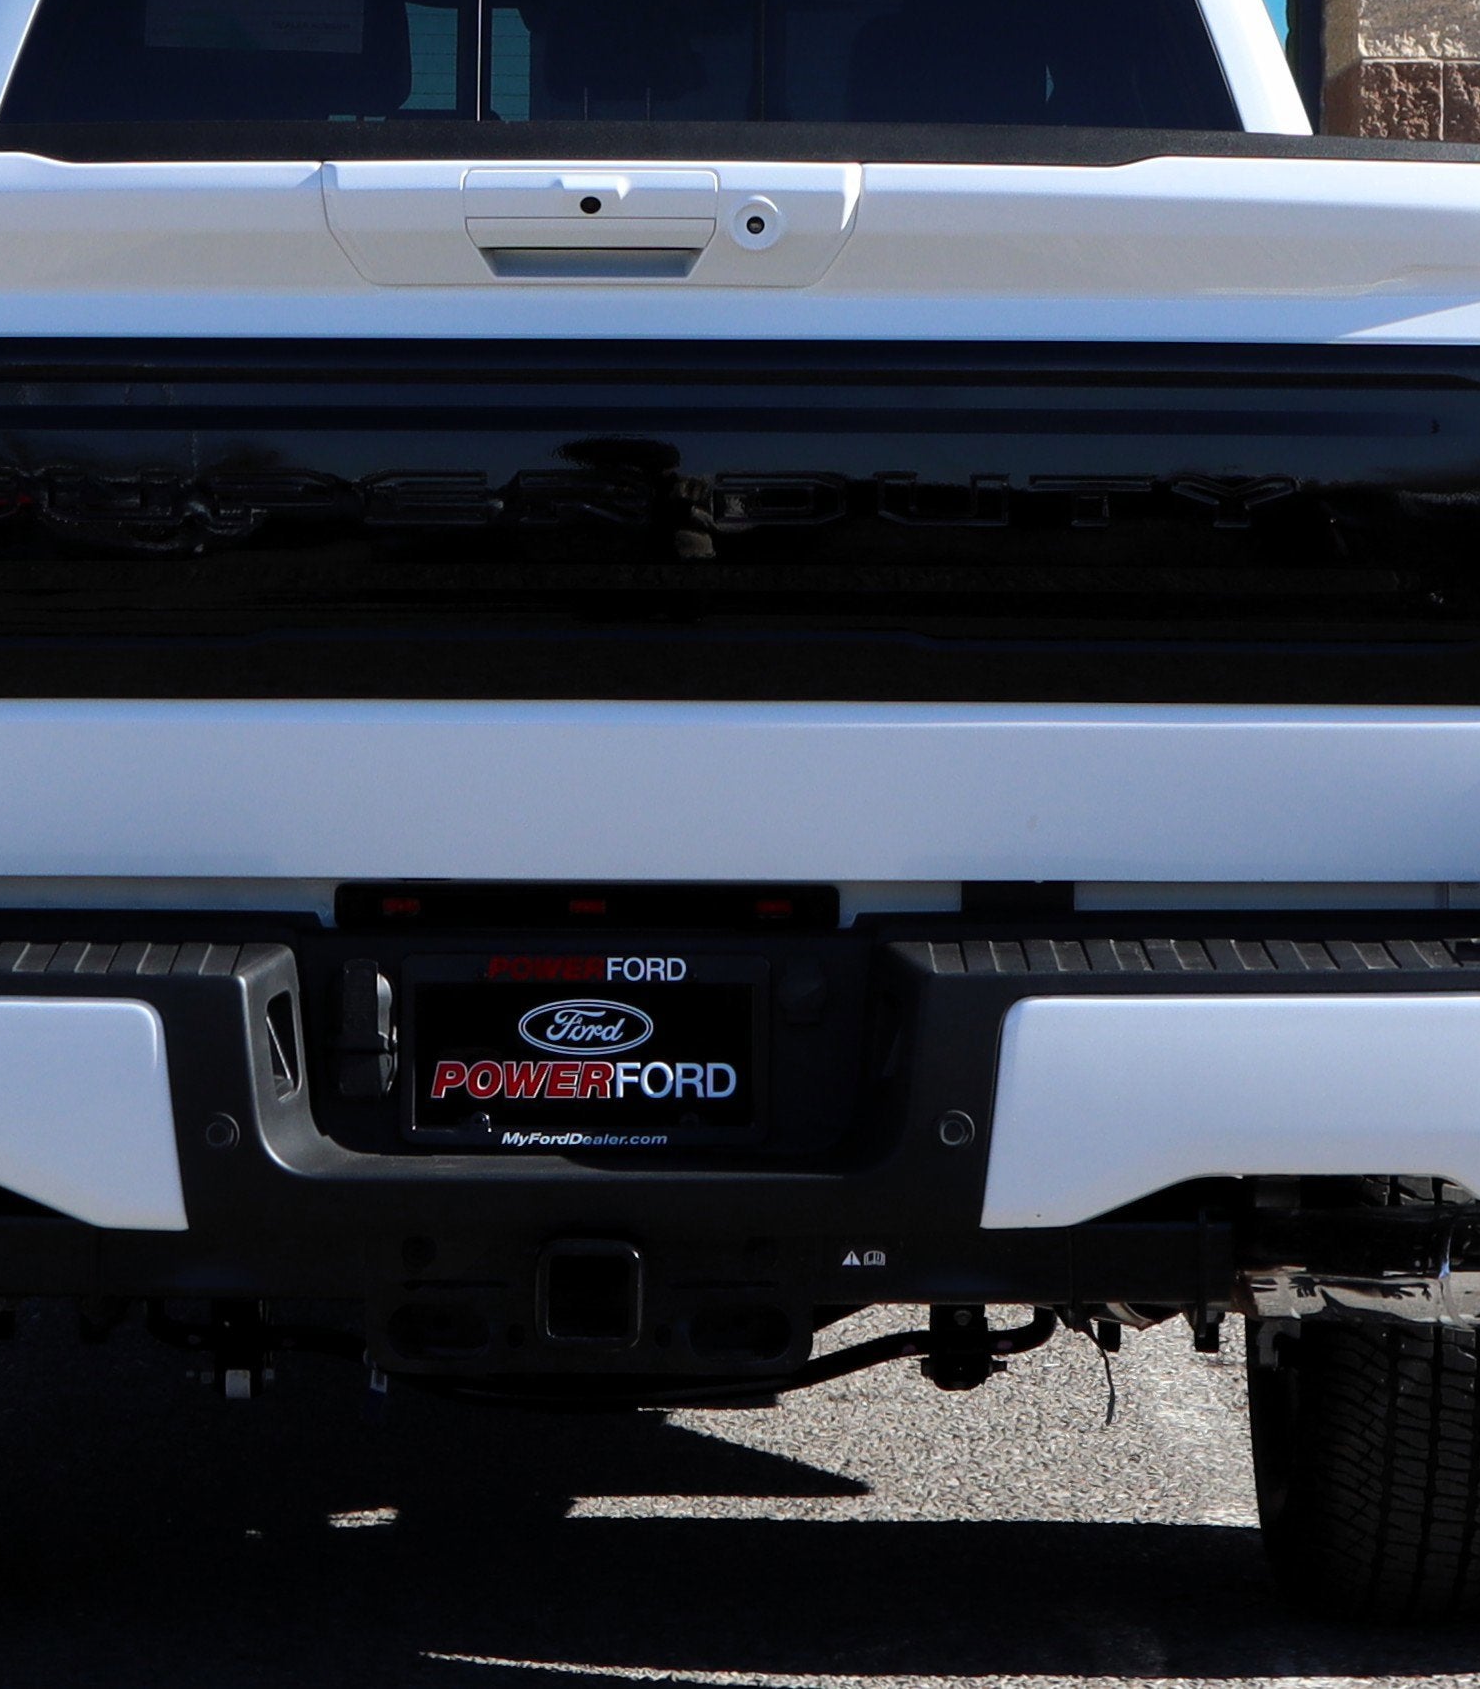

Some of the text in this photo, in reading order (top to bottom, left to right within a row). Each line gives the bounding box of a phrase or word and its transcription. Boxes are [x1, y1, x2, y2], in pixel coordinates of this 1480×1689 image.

[716, 471, 1295, 529] DUTY
[545, 1008, 625, 1043] Ford
[431, 1060, 737, 1099] POWERFORD
[501, 1131, 668, 1147] MyFordDealer.com
